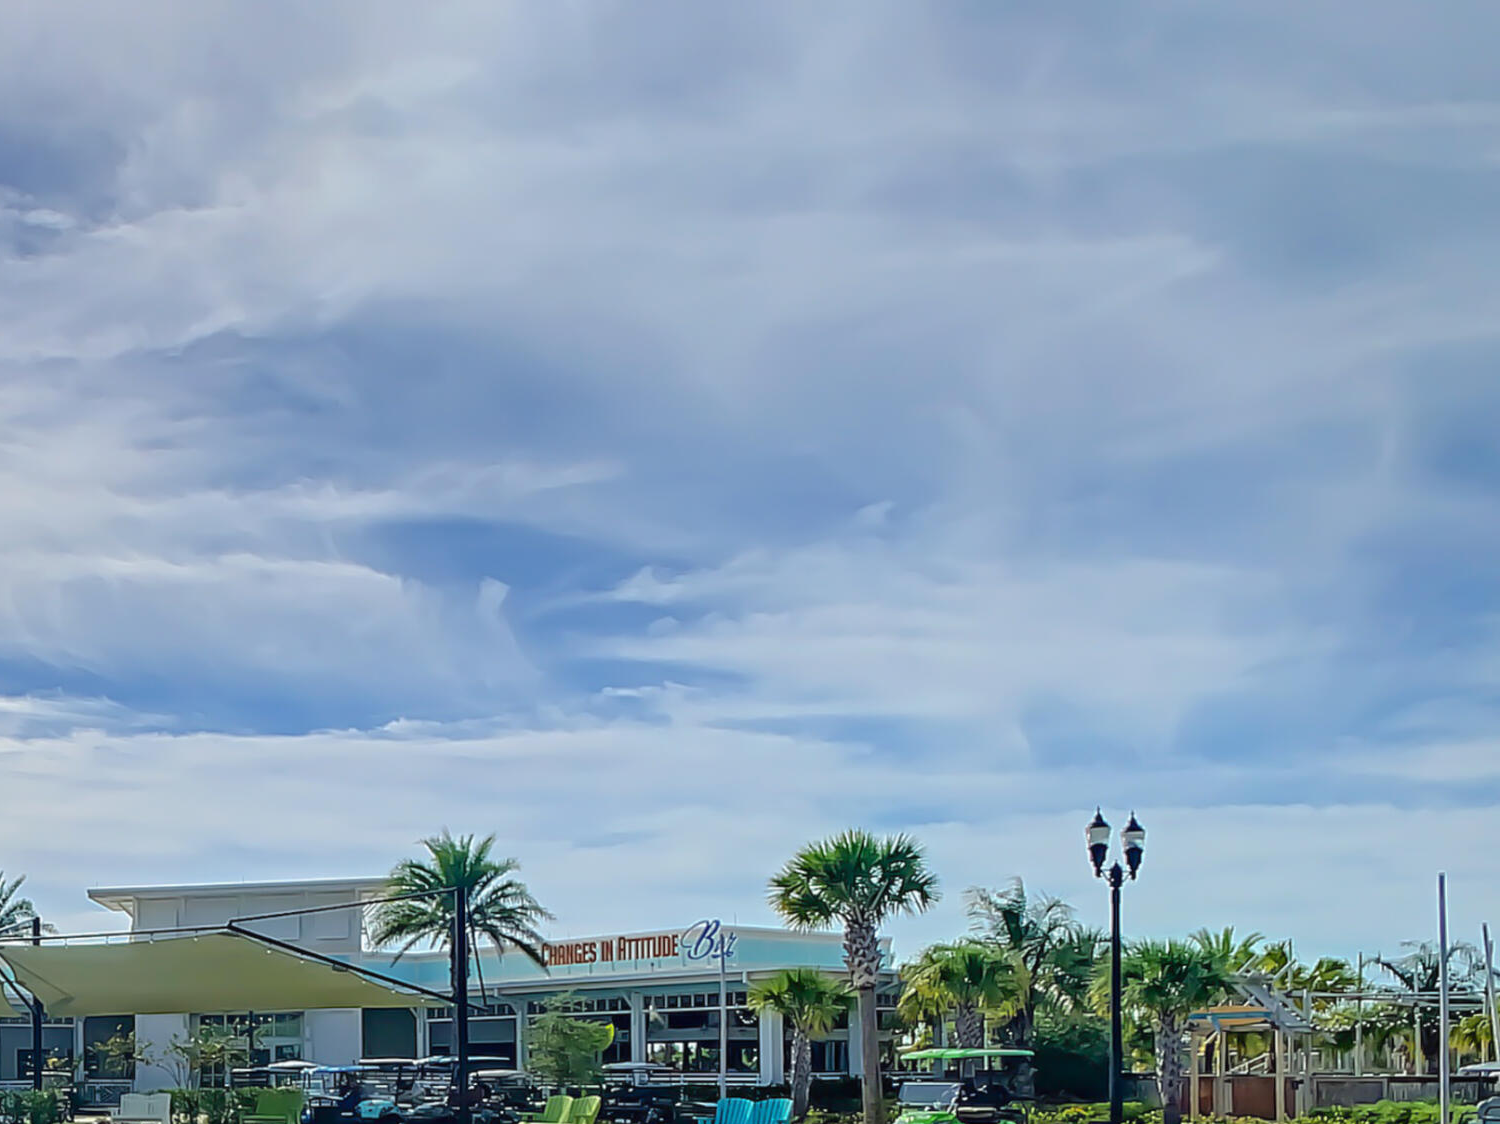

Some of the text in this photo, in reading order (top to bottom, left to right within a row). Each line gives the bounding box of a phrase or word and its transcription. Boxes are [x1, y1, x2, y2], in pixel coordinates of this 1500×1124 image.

[541, 919, 737, 967] CHANGES IN ATTITUDE Bar
